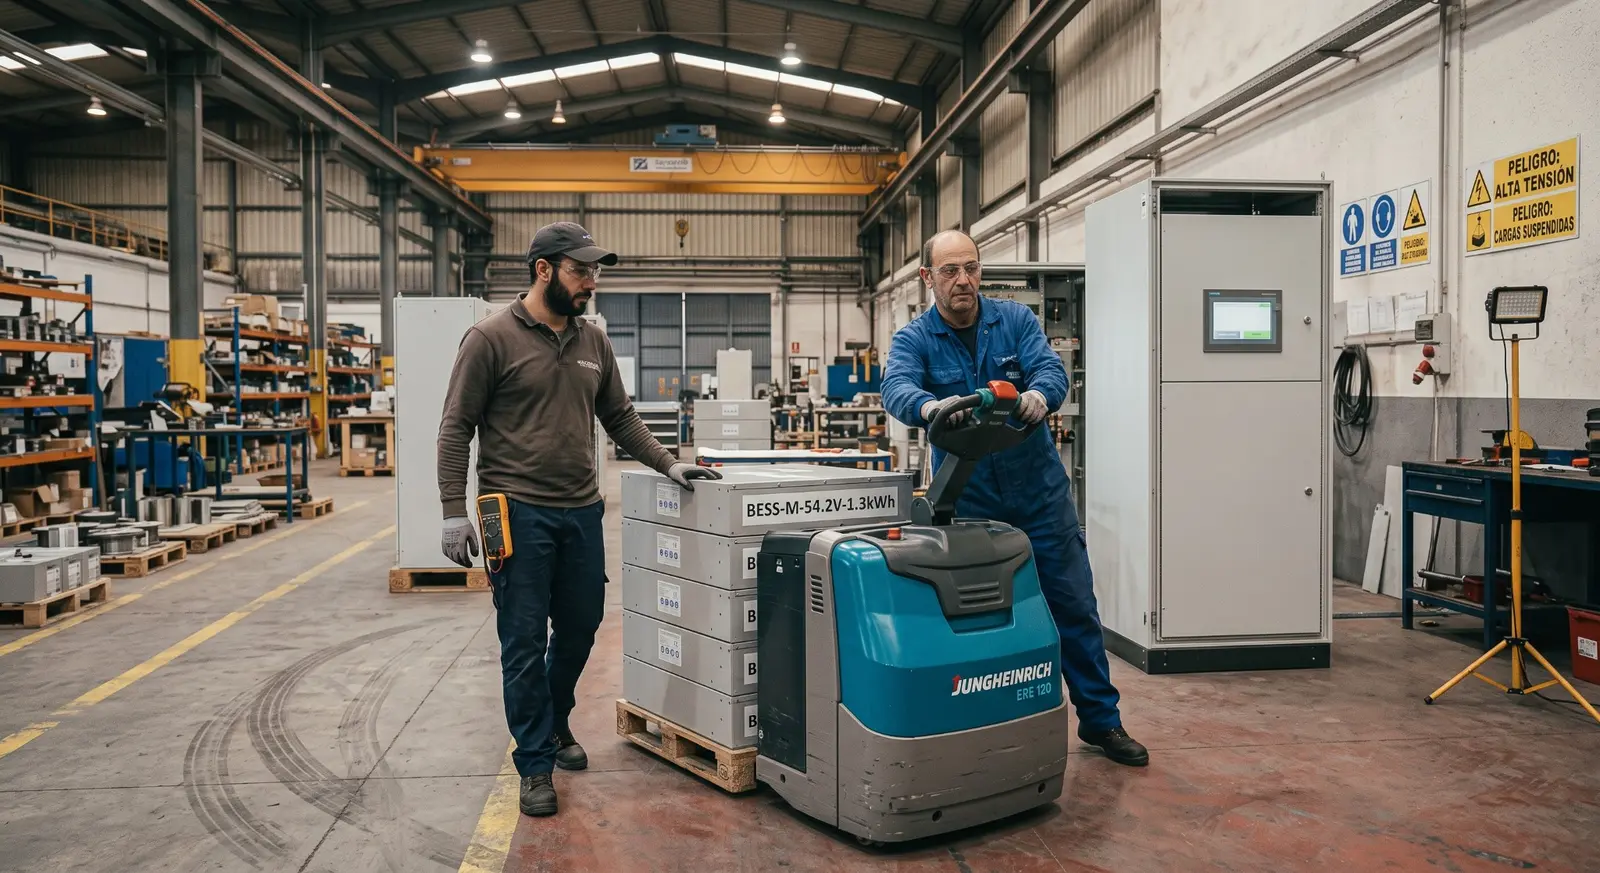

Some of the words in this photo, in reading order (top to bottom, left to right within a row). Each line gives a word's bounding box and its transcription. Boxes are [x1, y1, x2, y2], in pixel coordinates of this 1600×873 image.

[1508, 149, 1560, 176] PELIGRO:
[1494, 180, 1521, 200] ALTA
[1523, 165, 1574, 193] TENSIÓN
[1512, 200, 1553, 222] PELIGRO:
[1494, 226, 1522, 243] CARGAS
[1522, 216, 1575, 239] SUSPENDIDAS
[747, 495, 895, 517] BESS-M-54.2V-1.3kWh
[951, 661, 1053, 697] JUNGHEINRICH
[1016, 686, 1035, 701] ERE
[1036, 682, 1052, 696] 120
